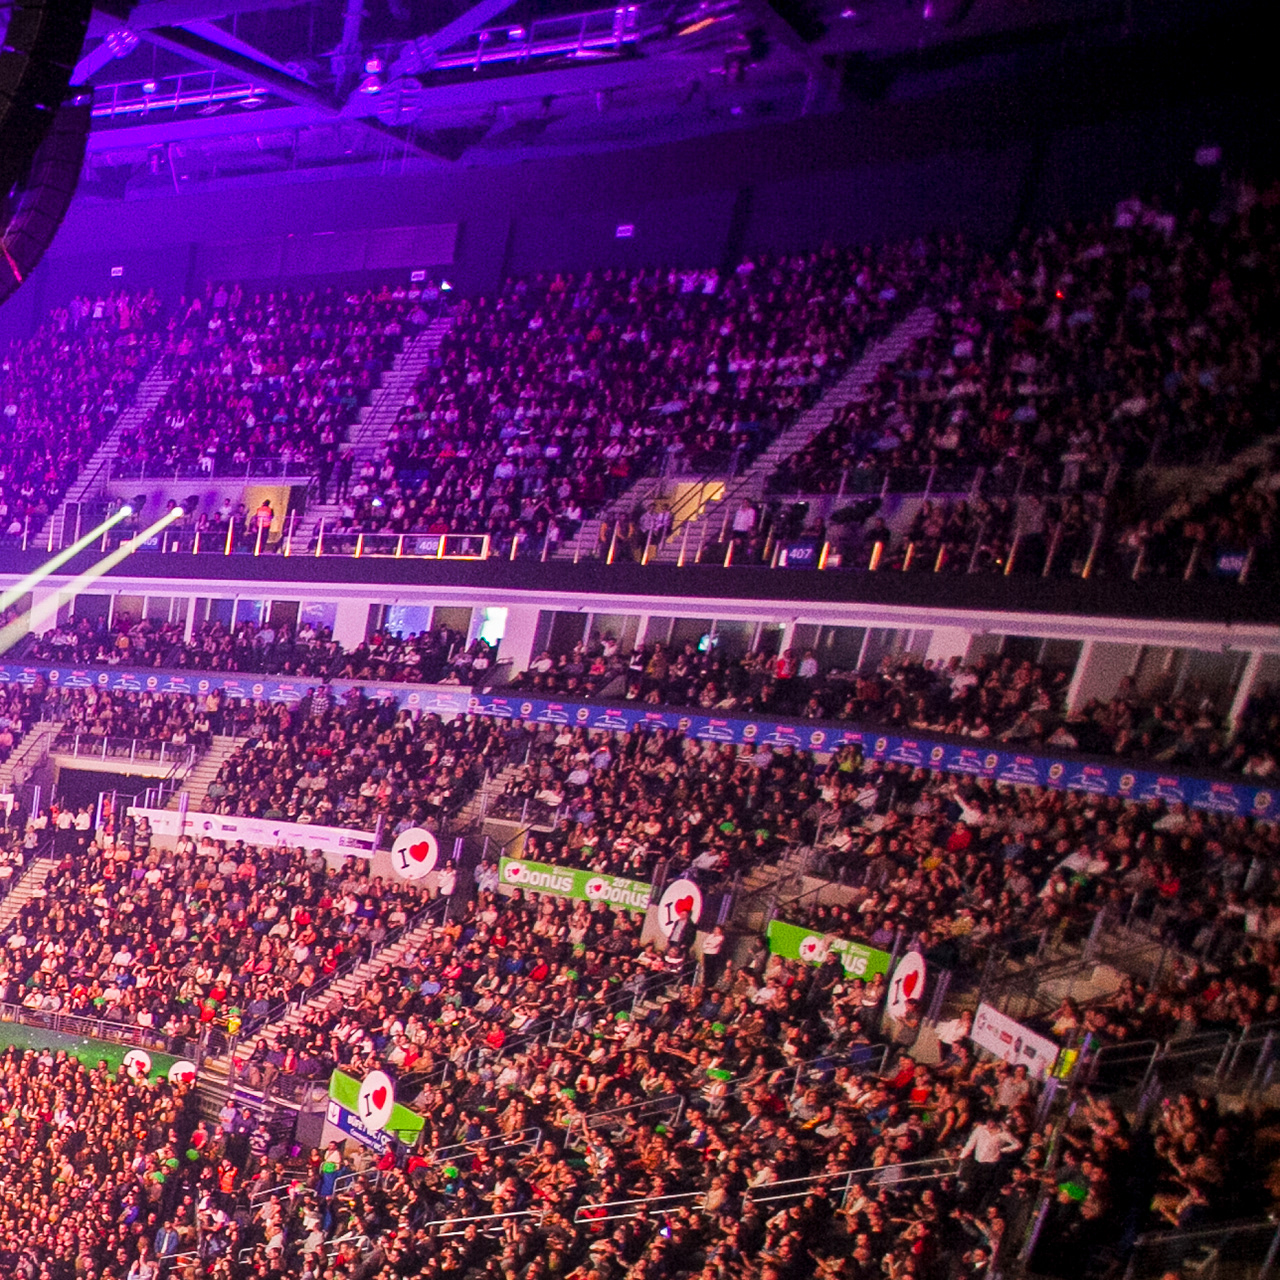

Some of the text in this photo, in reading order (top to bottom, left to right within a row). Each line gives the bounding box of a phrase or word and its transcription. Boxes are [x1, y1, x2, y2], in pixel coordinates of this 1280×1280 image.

[789, 548, 813, 558] 407
[518, 863, 574, 893] bonus
[600, 880, 650, 909] bonus
